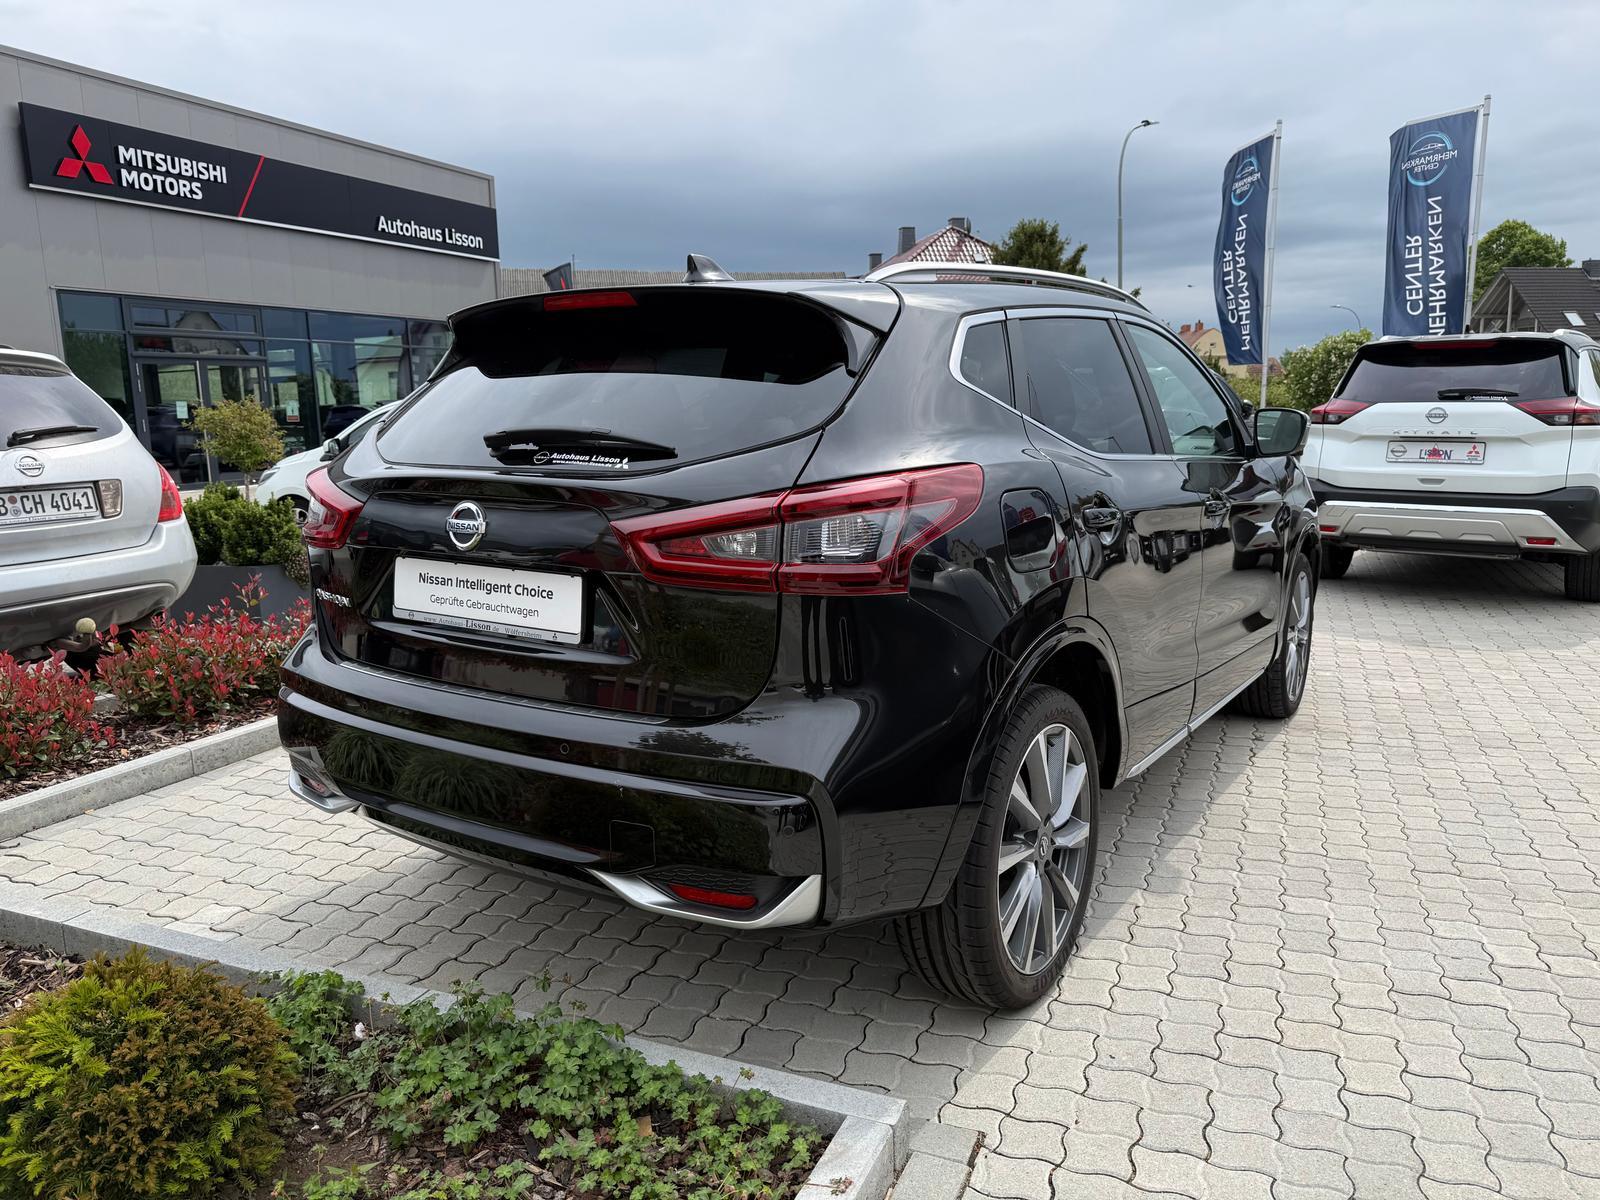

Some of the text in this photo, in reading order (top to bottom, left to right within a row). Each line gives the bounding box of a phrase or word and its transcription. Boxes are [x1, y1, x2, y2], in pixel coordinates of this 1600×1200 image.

[117, 144, 228, 184] MITSUBISHI
[120, 168, 203, 200] MOTORS
[377, 215, 484, 249] Autohaus Lisson
[550, 452, 590, 461] Autohaus
[591, 455, 620, 463] Lisson
[20, 494, 46, 514] CH
[50, 491, 94, 512] 4041
[447, 521, 479, 531] NISSAN
[418, 572, 554, 600] Nissan Intelligent Choice
[429, 594, 539, 618] Geprüfte Gebrauchtwagen
